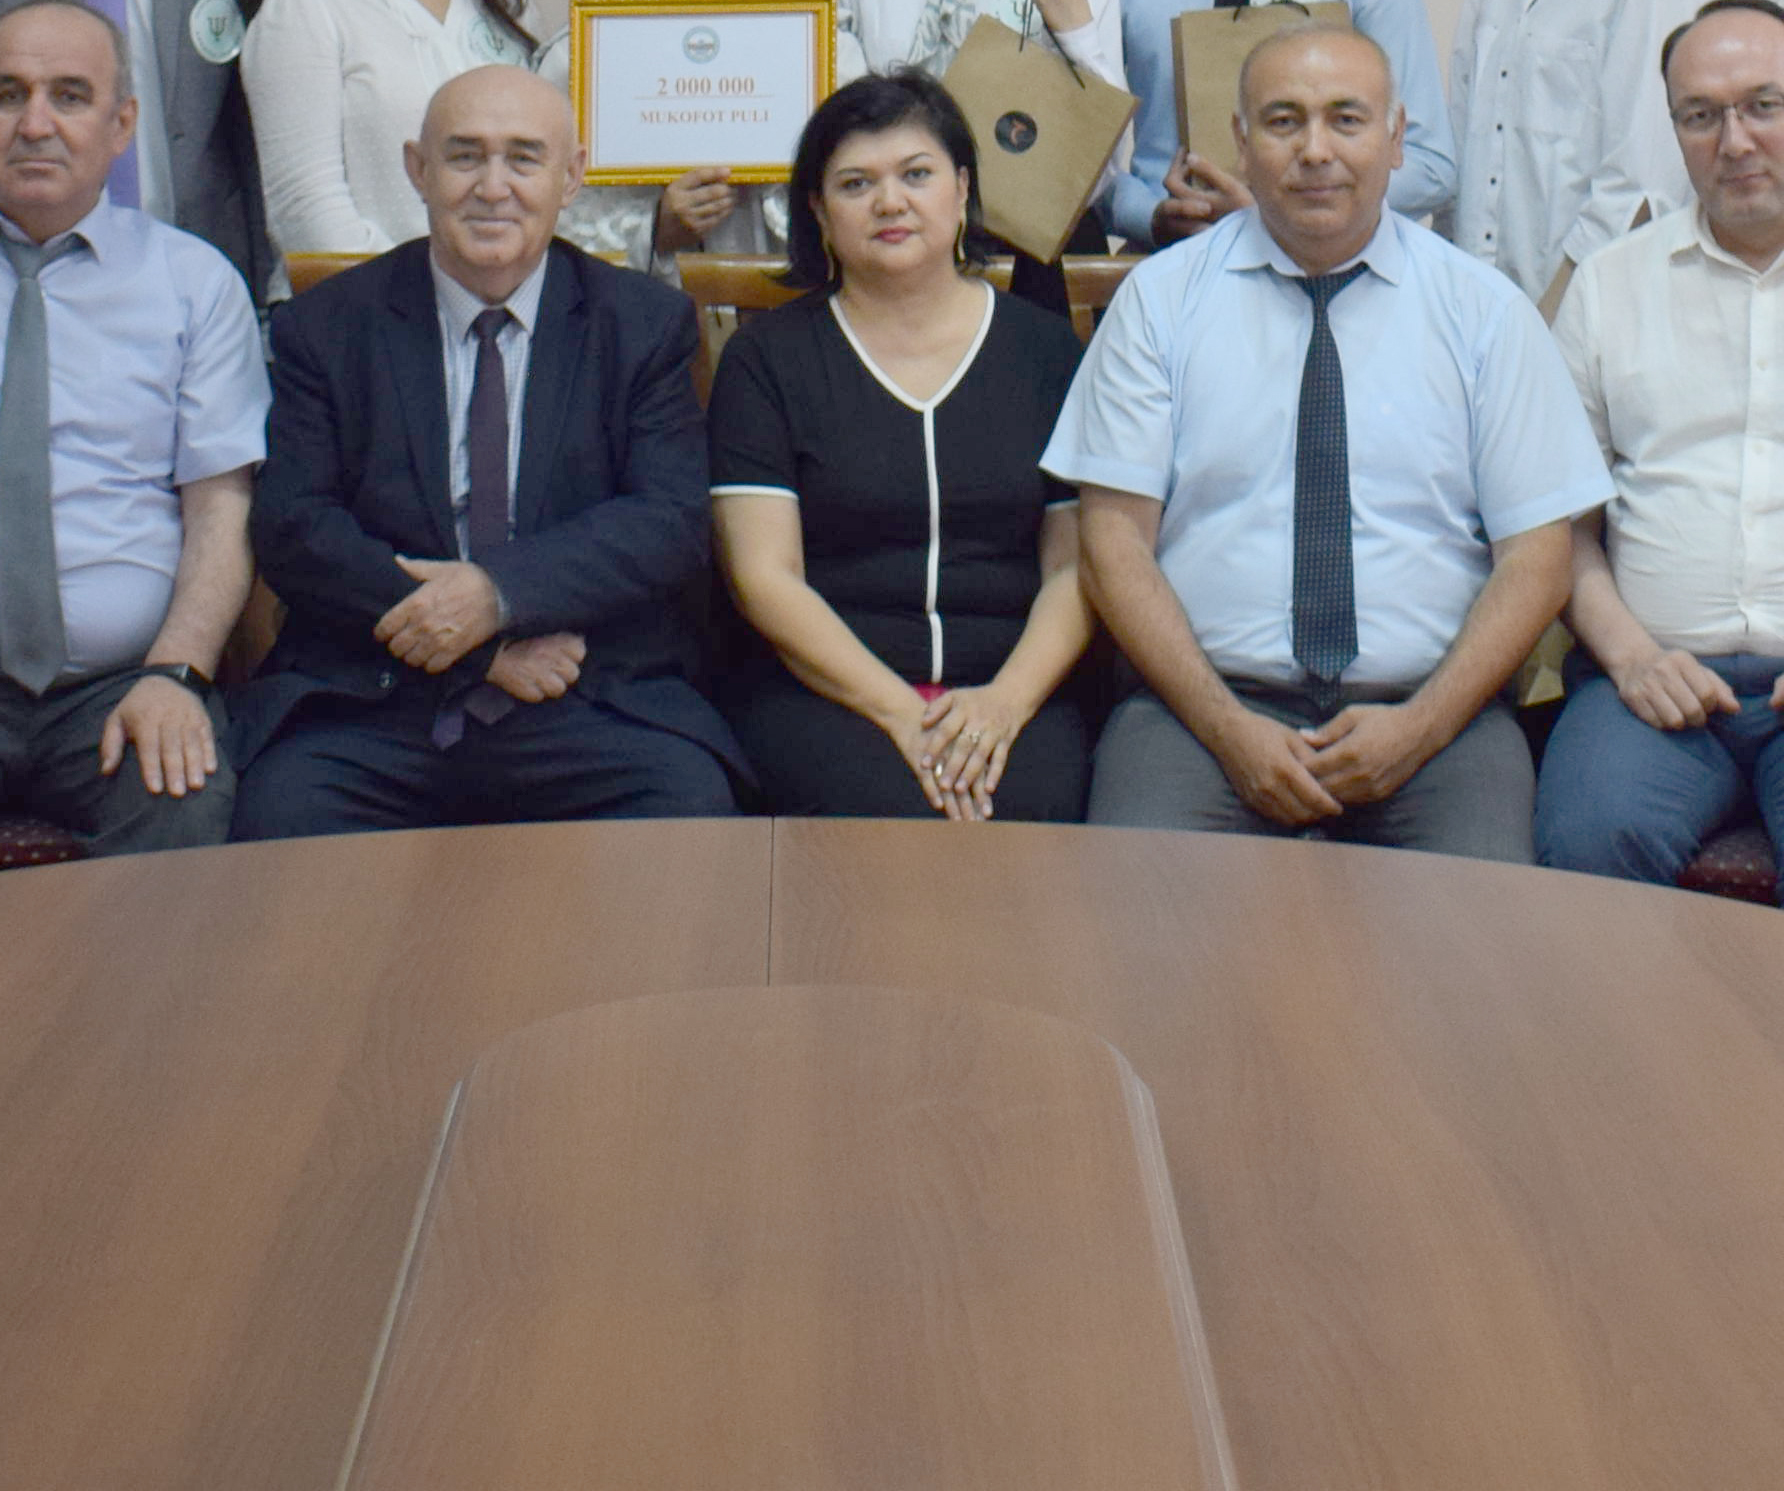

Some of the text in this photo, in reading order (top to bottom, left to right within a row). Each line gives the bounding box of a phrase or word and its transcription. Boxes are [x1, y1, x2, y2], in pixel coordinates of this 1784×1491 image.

[657, 75, 755, 95] 2 000 000
[640, 109, 769, 124] MUKOFOT PULI
